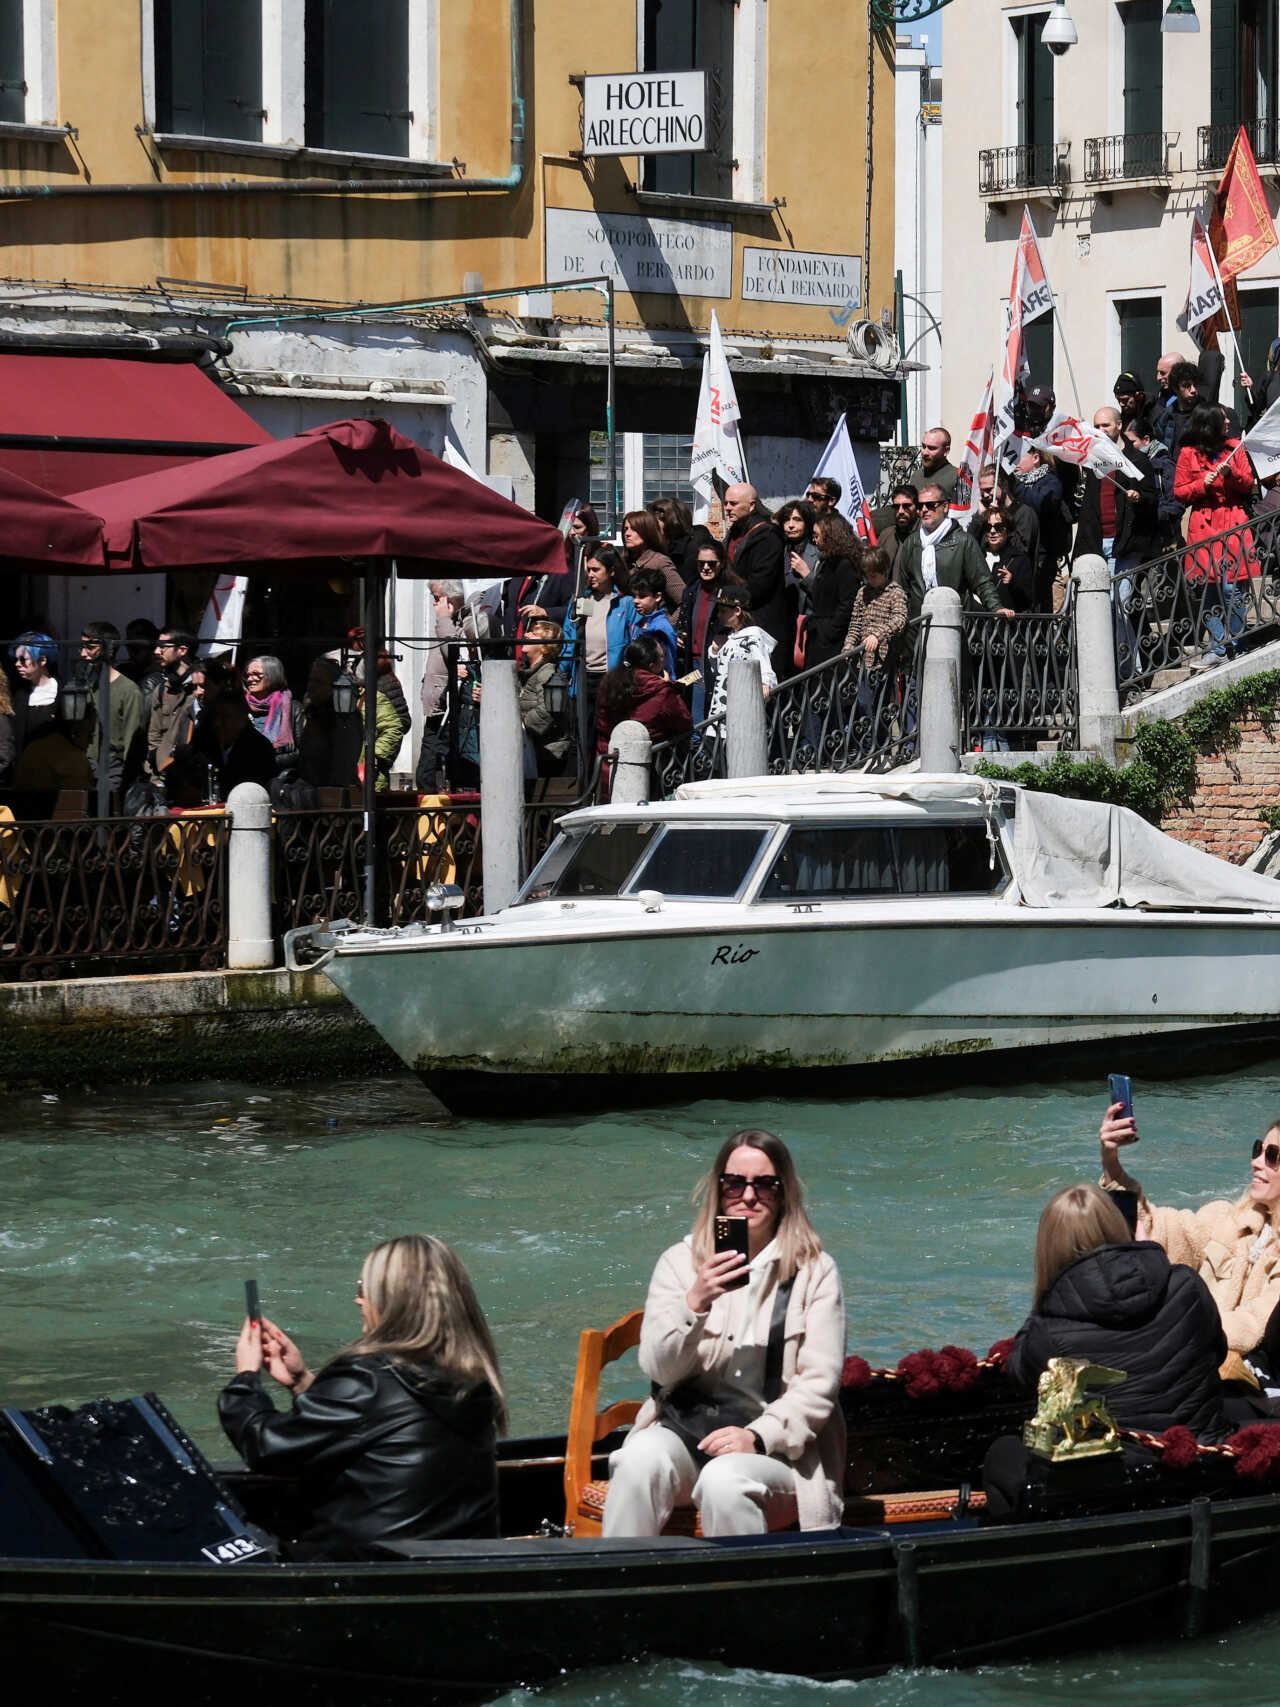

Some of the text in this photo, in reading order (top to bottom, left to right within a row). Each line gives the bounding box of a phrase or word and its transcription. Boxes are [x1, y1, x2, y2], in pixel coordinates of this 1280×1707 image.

[606, 80, 685, 110] HOTEL
[586, 114, 703, 147] ARLECCHINO
[587, 228, 695, 251] SOTOPORTEGO
[564, 255, 585, 273] DE
[637, 261, 715, 281] BERNARDO
[758, 256, 846, 278] FONDAMENTA
[745, 276, 764, 293] DE
[791, 280, 859, 298] BERNARDO
[710, 943, 760, 965] Rio
